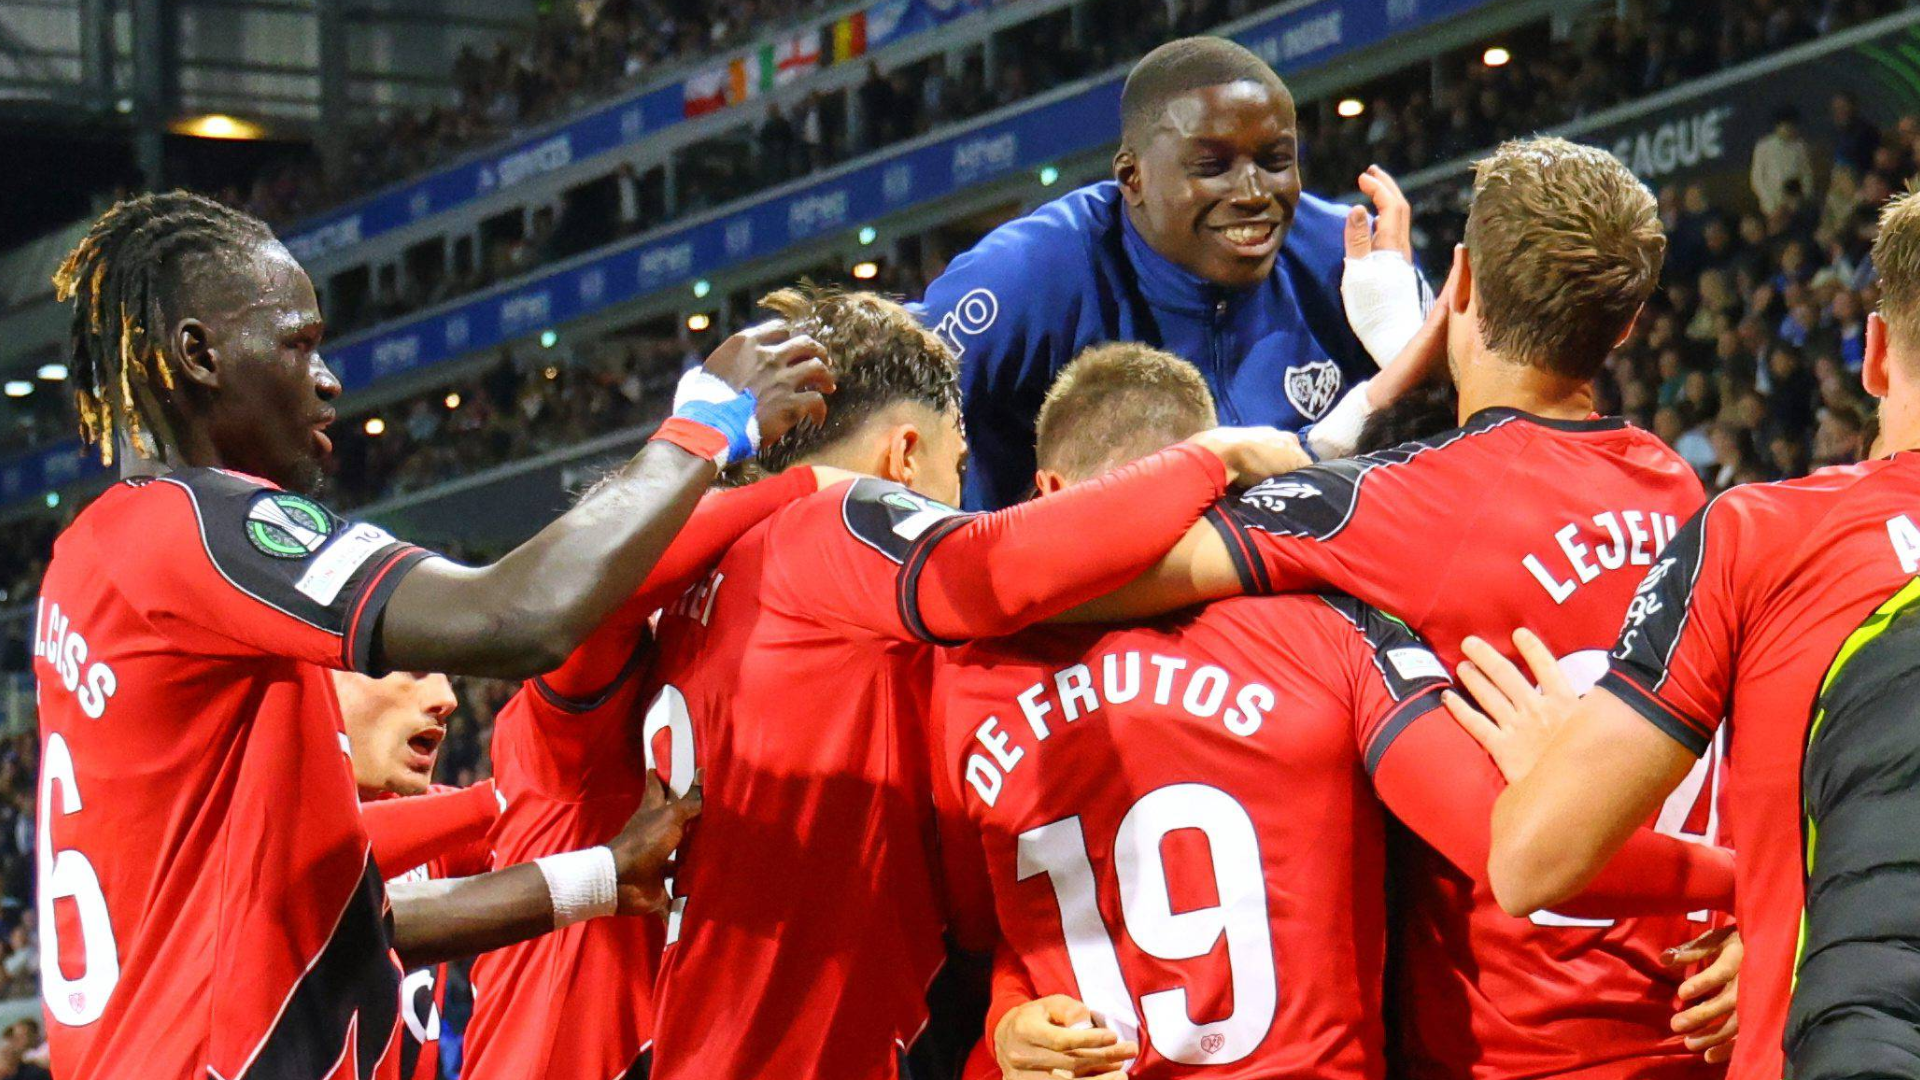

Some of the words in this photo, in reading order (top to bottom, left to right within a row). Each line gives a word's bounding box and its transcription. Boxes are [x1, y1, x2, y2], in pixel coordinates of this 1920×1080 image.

[965, 715, 1024, 808] DE
[1016, 651, 1275, 738] FRUTOS
[38, 731, 120, 1026] 6
[1017, 782, 1277, 1077] 19
